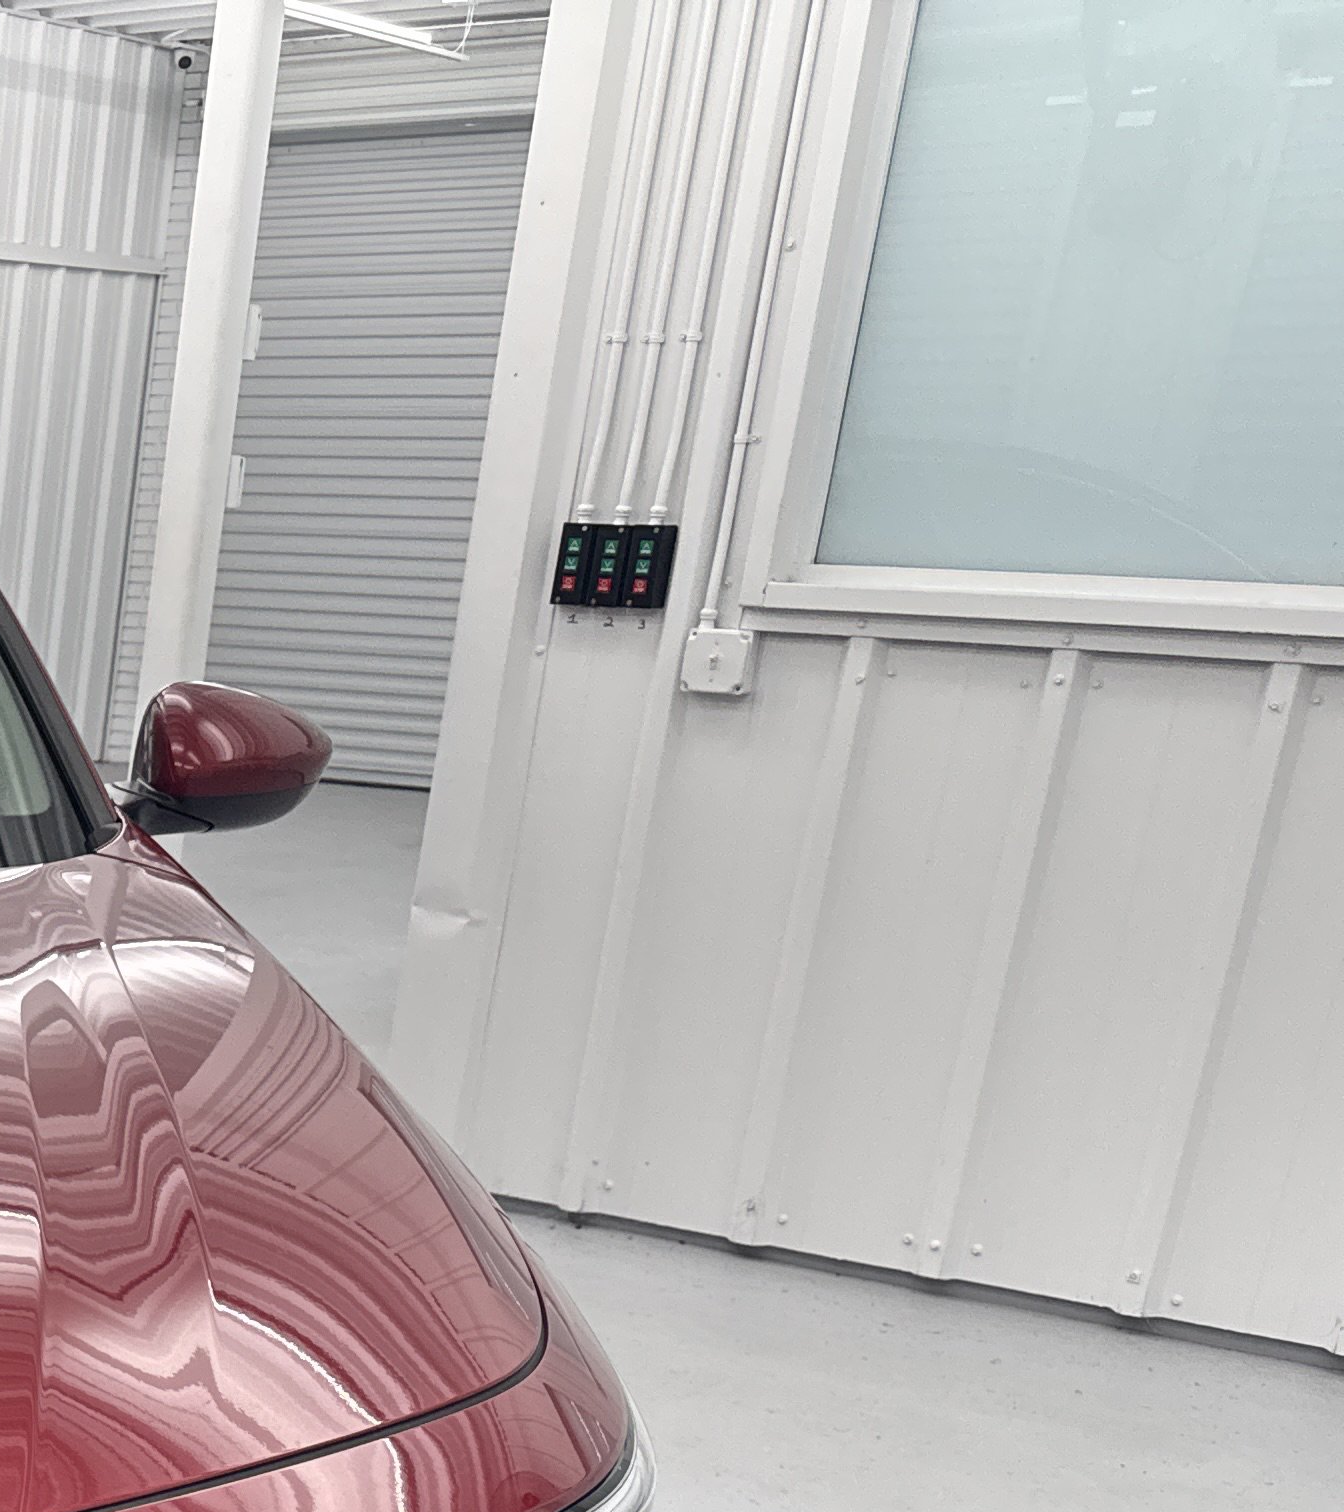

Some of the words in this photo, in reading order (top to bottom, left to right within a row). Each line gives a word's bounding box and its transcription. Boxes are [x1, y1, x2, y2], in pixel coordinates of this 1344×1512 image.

[567, 613, 578, 624] 1
[603, 616, 614, 628] 2
[637, 619, 646, 630] 3
